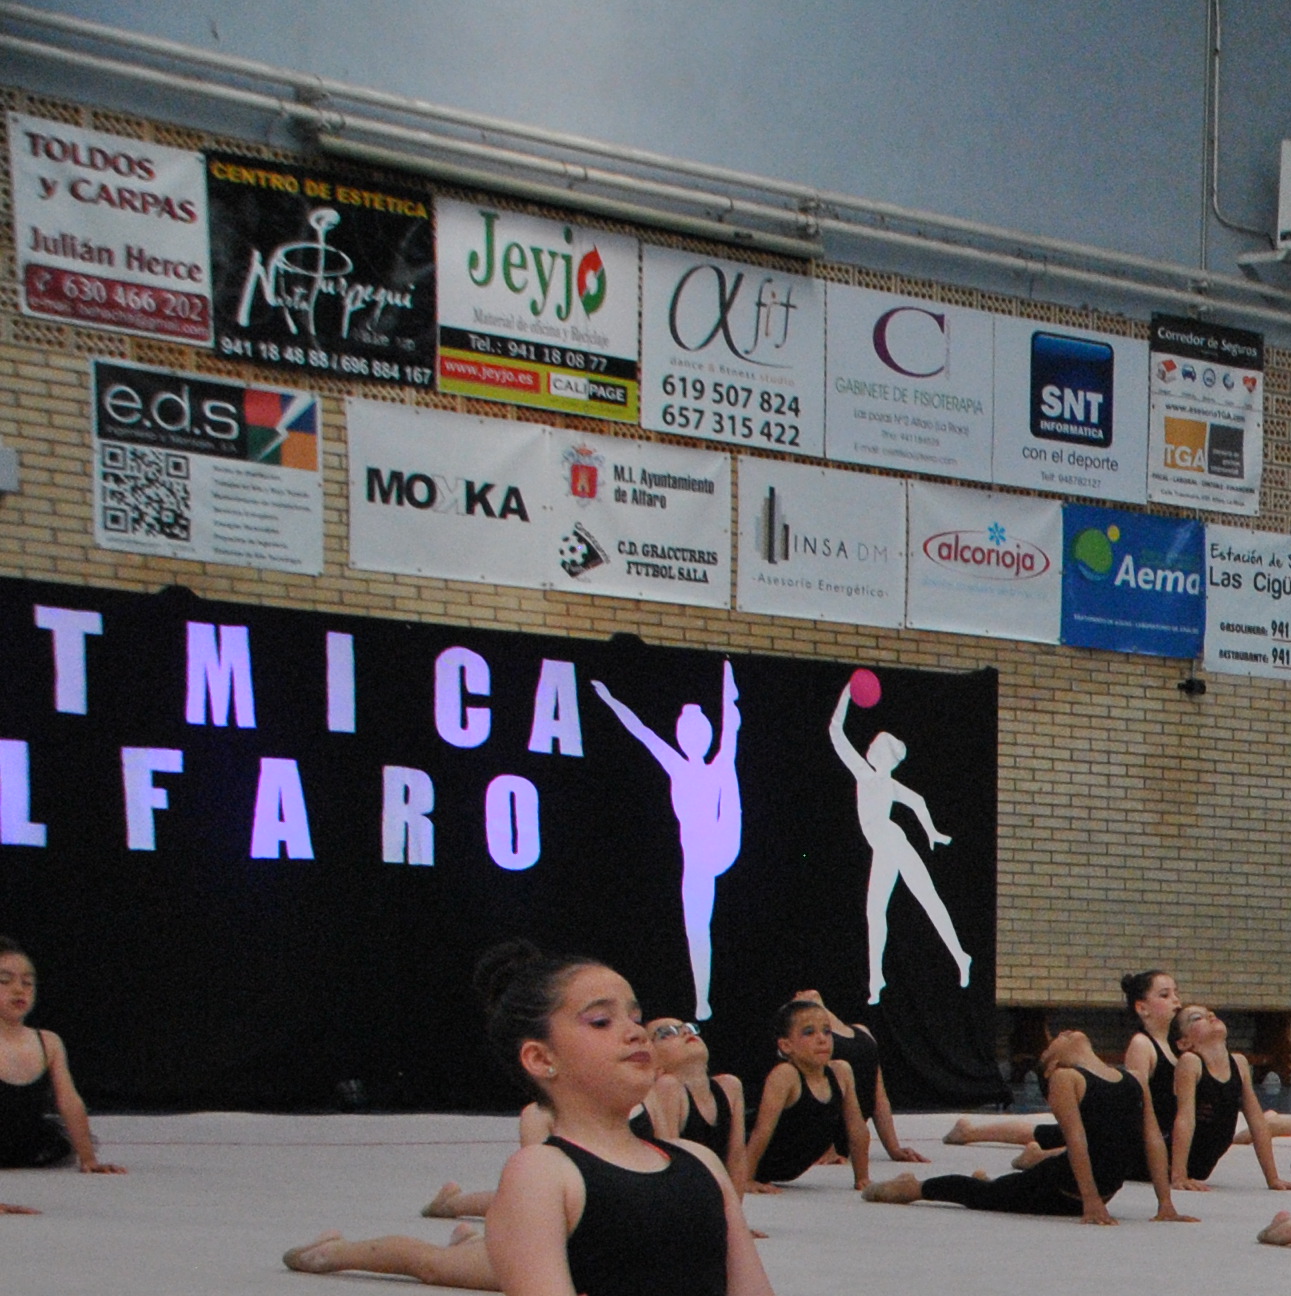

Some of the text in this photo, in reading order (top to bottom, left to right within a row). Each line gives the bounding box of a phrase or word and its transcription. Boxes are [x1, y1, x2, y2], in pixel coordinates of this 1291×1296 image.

[26, 131, 156, 181] TOLDOS
[211, 161, 299, 193] CENTRO
[303, 178, 332, 199] DE
[38, 176, 199, 225] y CARPAS
[125, 244, 204, 283] Herce
[63, 274, 107, 304] 630
[161, 292, 203, 322] 202
[507, 340, 536, 361] 941
[543, 347, 562, 365] 18
[566, 352, 586, 370] 08
[589, 356, 608, 373] 77
[1157, 326, 1206, 347] Corredor
[1207, 336, 1218, 350] de
[1221, 339, 1258, 357] Seguros
[220, 336, 252, 358] 941
[258, 343, 281, 362] 18
[284, 346, 305, 365] 48
[340, 355, 370, 375] 696
[371, 360, 401, 380] 884
[404, 365, 432, 385] 167
[444, 360, 535, 386] www.jeyjo.es
[662, 374, 801, 418] 619 507 824
[835, 377, 985, 415] GABINETE DE FISIOTERAPIA
[1040, 384, 1104, 424] SNT
[662, 404, 801, 447] 657 315 422
[1022, 445, 1119, 473] con el deporte
[1164, 443, 1207, 469] TGA
[613, 464, 716, 496] M.I. Ayuntamiento
[614, 485, 667, 510] de Alfaro
[641, 542, 719, 567] GRACCURRIS
[937, 533, 1035, 577] alcorioja
[1211, 542, 1263, 567] Estación
[1269, 553, 1283, 570] de
[626, 560, 710, 585] FUTBOL SALA
[1114, 553, 1201, 596] Aema
[1209, 565, 1243, 589] Las
[1271, 619, 1290, 639] 941
[1271, 647, 1290, 666] 941
